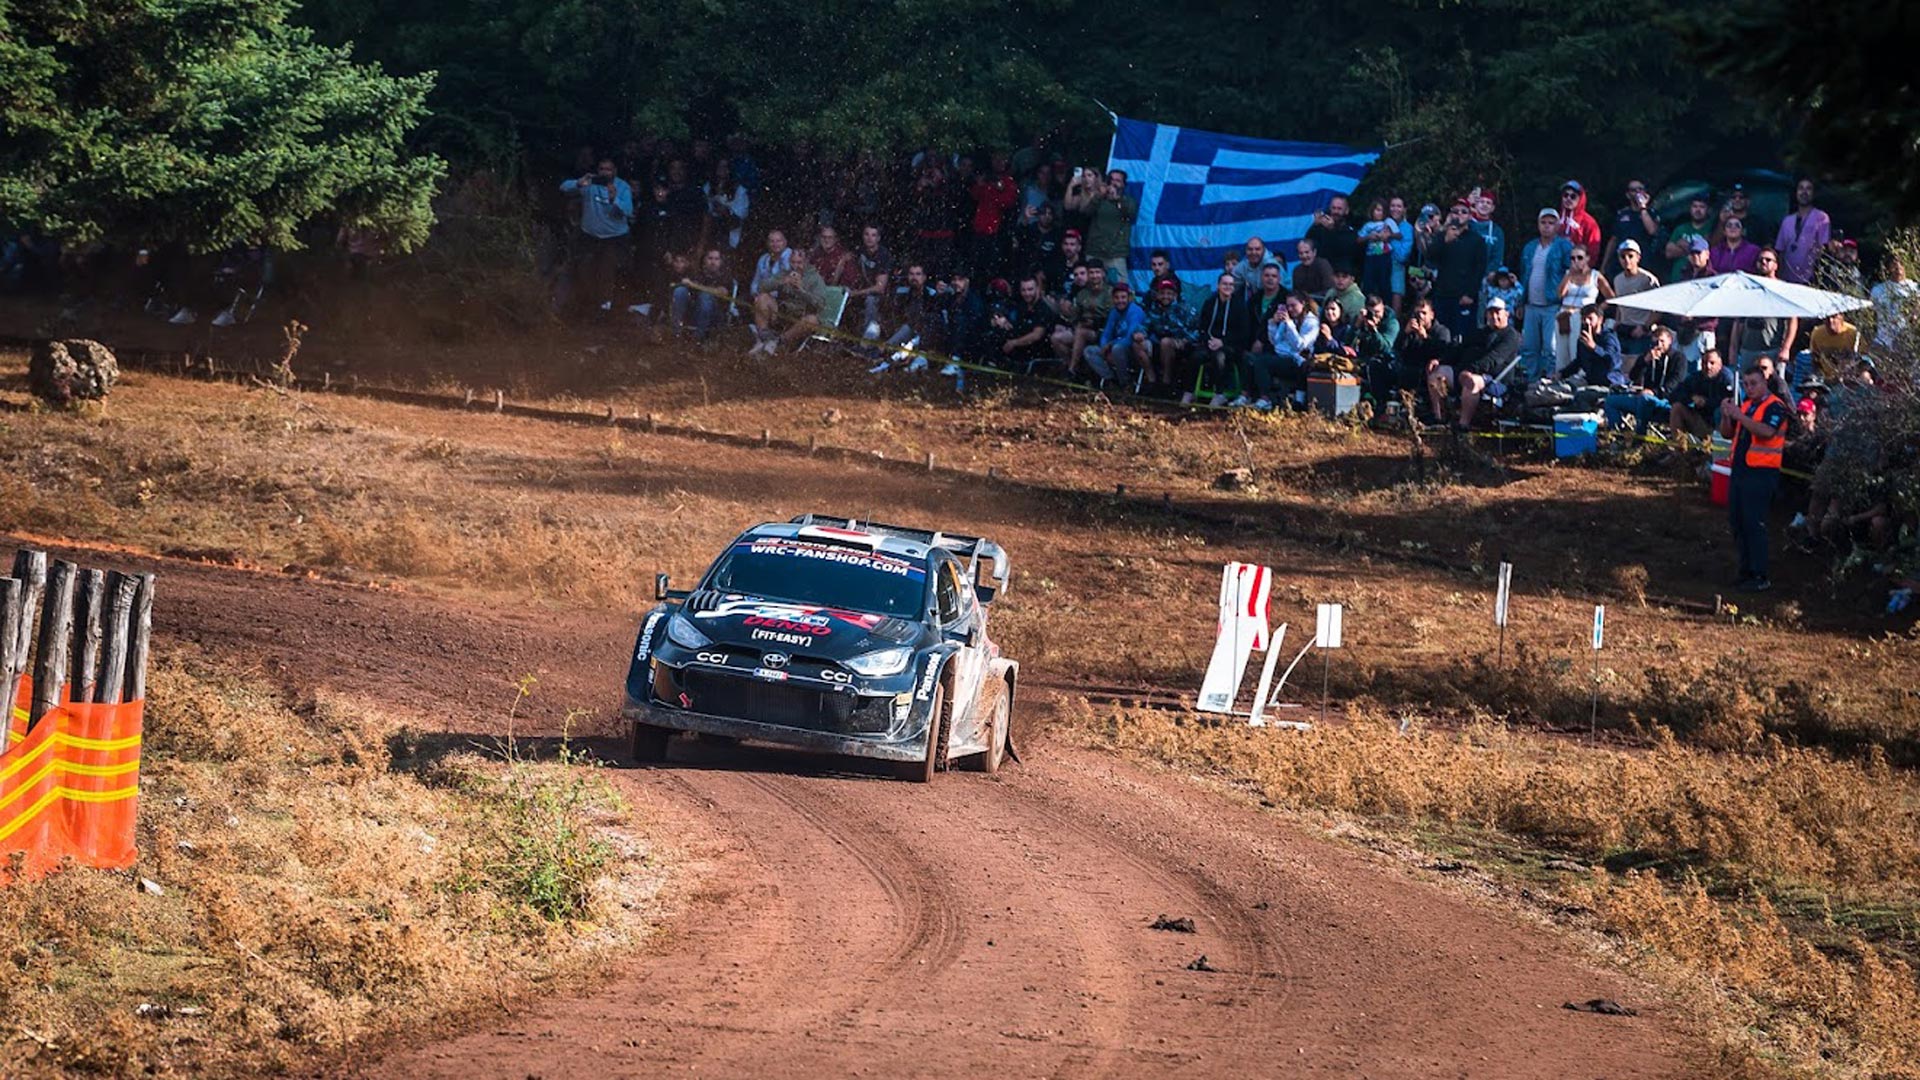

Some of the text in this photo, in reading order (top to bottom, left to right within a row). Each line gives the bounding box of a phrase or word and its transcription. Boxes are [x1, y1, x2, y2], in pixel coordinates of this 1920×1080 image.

[750, 544, 909, 576] WRC-FANSHOP.COM
[742, 615, 832, 635] DENSO
[696, 652, 729, 665] CCI
[820, 669, 853, 684] CCI
